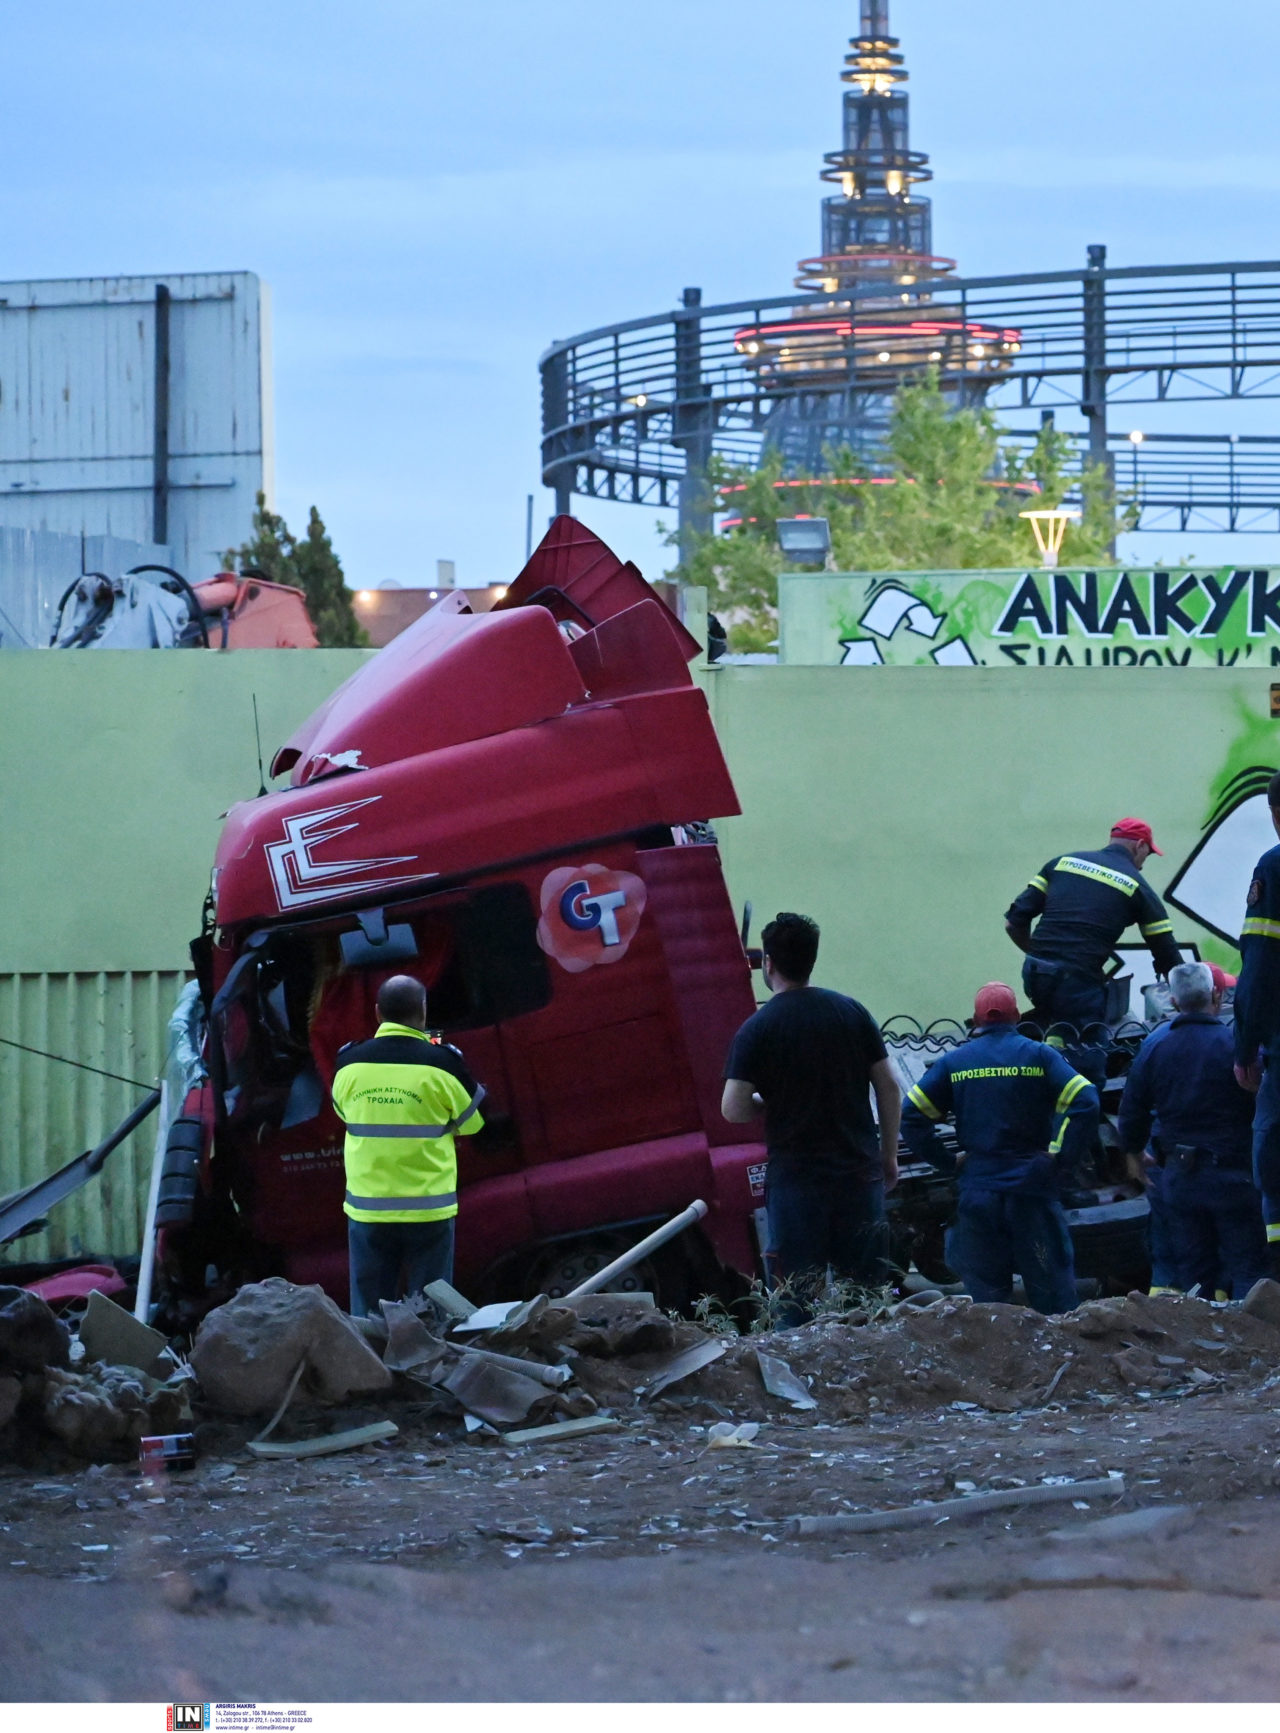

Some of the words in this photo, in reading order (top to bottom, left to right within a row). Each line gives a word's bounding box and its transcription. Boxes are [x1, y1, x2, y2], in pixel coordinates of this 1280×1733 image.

[561, 880, 627, 947] GT
[950, 1066, 1019, 1083] ΠΥΡΟΣΒΕΣΤΙΚΟ
[1020, 1066, 1045, 1077] ΣΩΜΑ
[367, 1096, 404, 1105] ΤΡΟΧΑΙΑ
